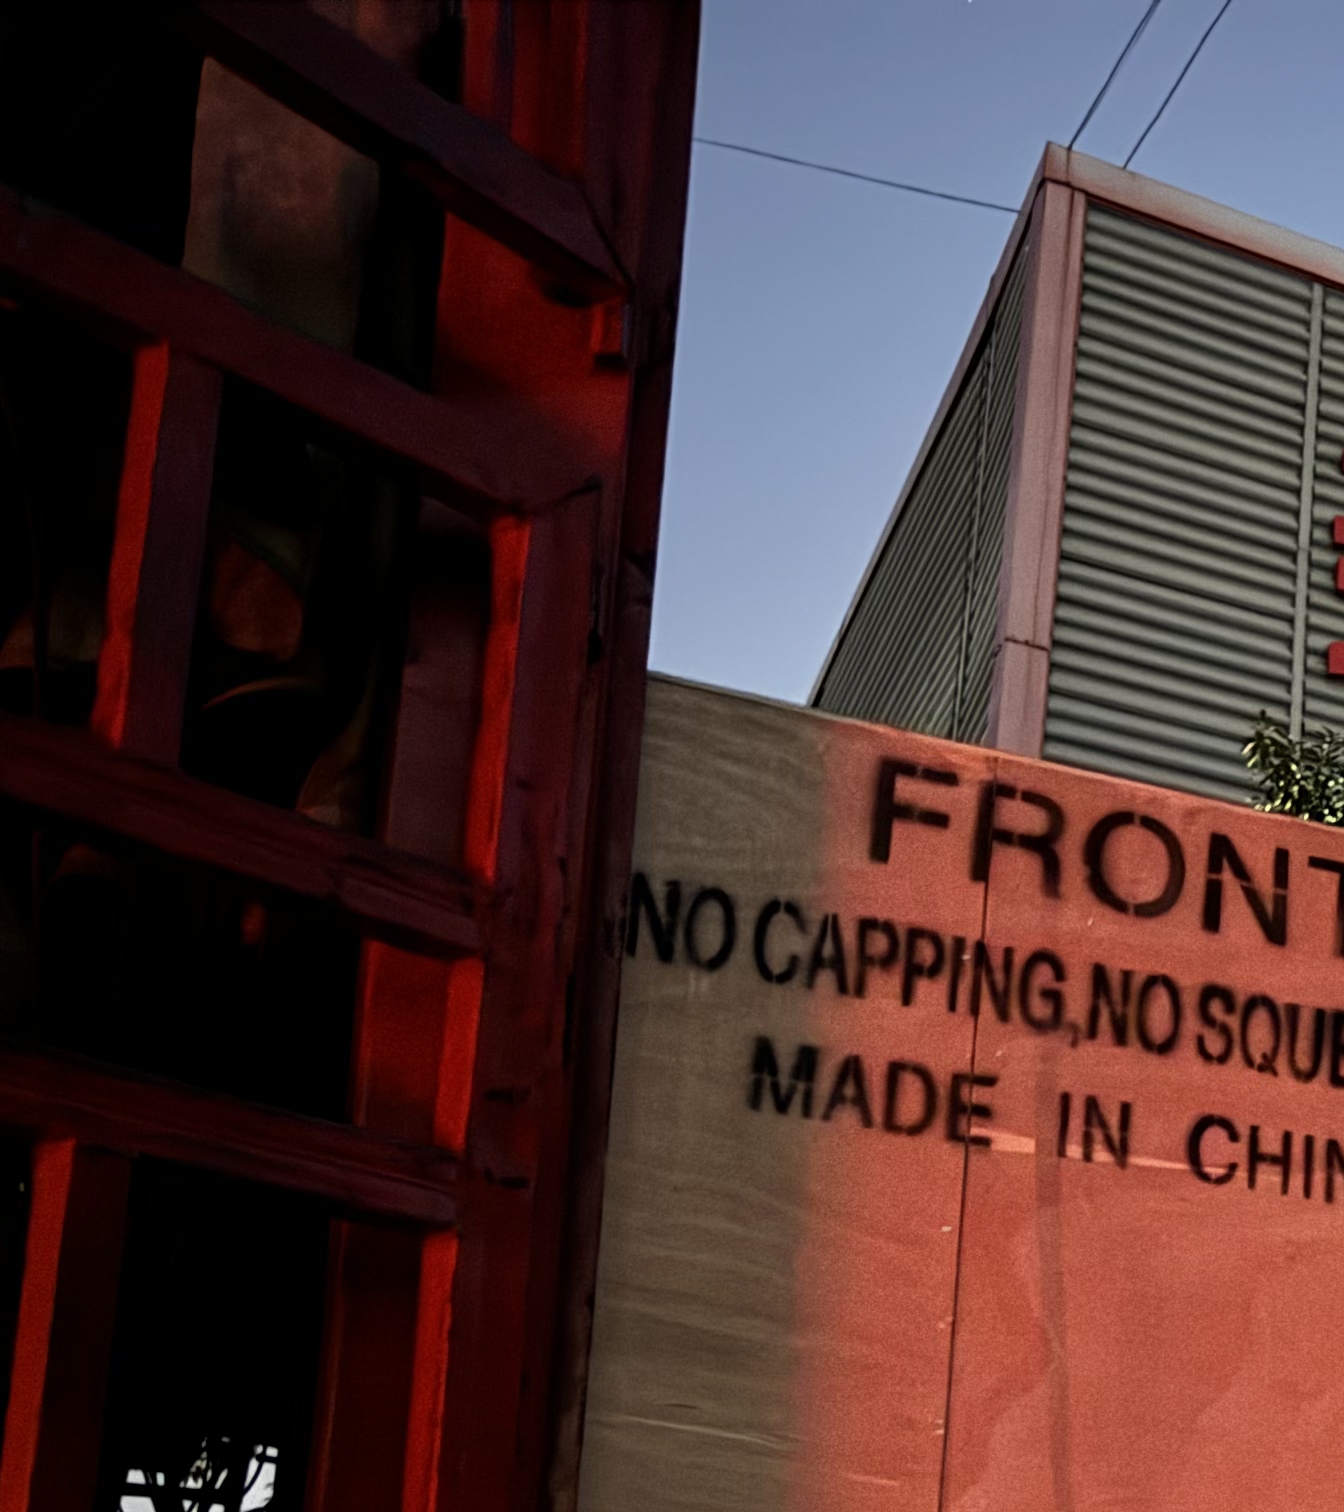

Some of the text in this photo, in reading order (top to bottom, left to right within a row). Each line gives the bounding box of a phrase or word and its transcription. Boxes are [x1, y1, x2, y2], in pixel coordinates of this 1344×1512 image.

[627, 873, 735, 971] NO
[746, 1035, 1000, 1147] MADE
[1056, 1089, 1132, 1168] IN
